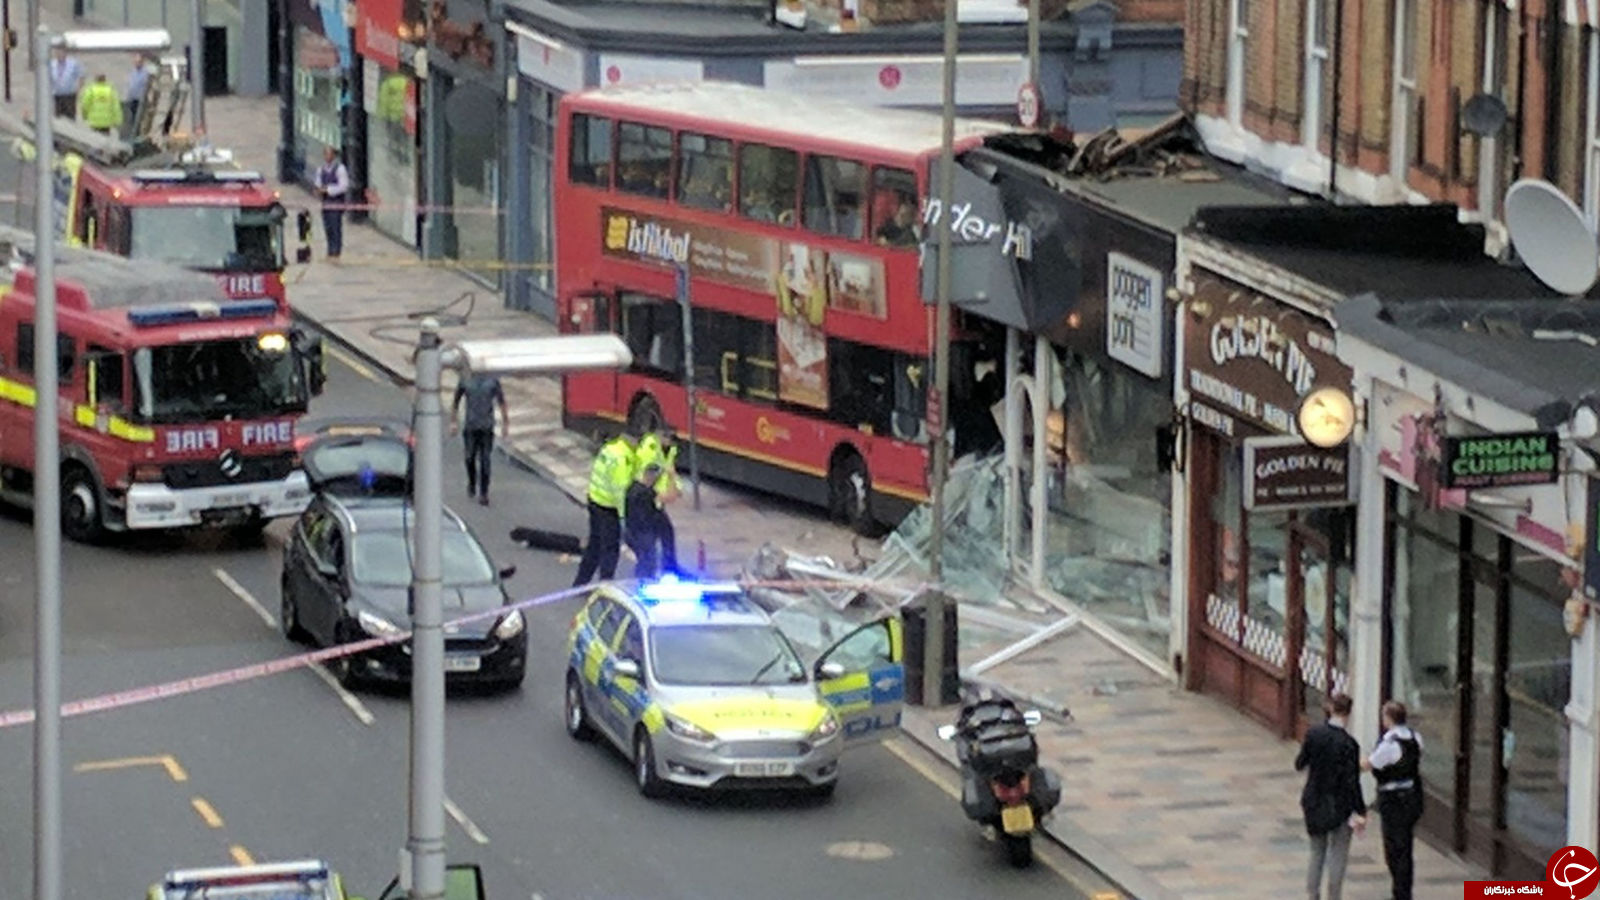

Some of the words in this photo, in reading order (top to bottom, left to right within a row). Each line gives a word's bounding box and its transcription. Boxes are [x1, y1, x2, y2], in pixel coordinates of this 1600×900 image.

[220, 273, 266, 294] IRE
[242, 421, 292, 446] FIRE
[1460, 437, 1548, 457] INDIAN
[1256, 455, 1320, 478] GOLDEN
[1322, 456, 1345, 474] PIE
[1452, 453, 1554, 475] CUISINE
